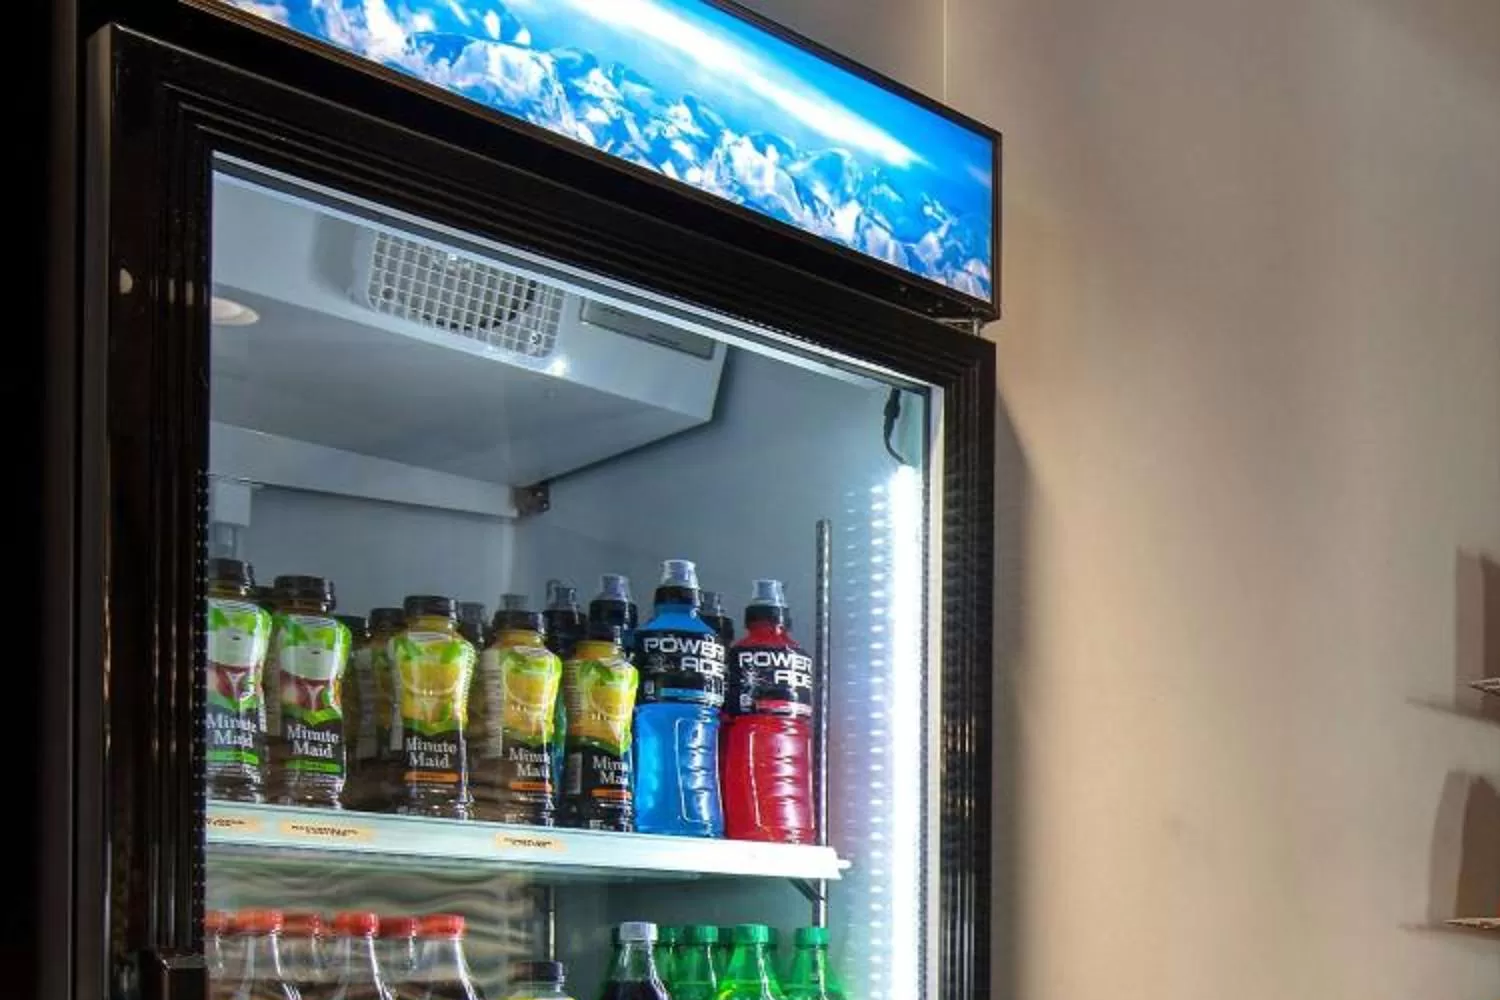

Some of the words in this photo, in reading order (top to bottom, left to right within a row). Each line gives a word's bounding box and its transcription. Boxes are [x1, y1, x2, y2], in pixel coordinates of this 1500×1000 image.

[643, 635, 725, 657] POWER
[738, 651, 813, 672] POWER
[287, 725, 340, 744] Minute
[292, 741, 333, 758] Maid
[405, 737, 457, 753] Minute
[409, 750, 449, 768] Maid
